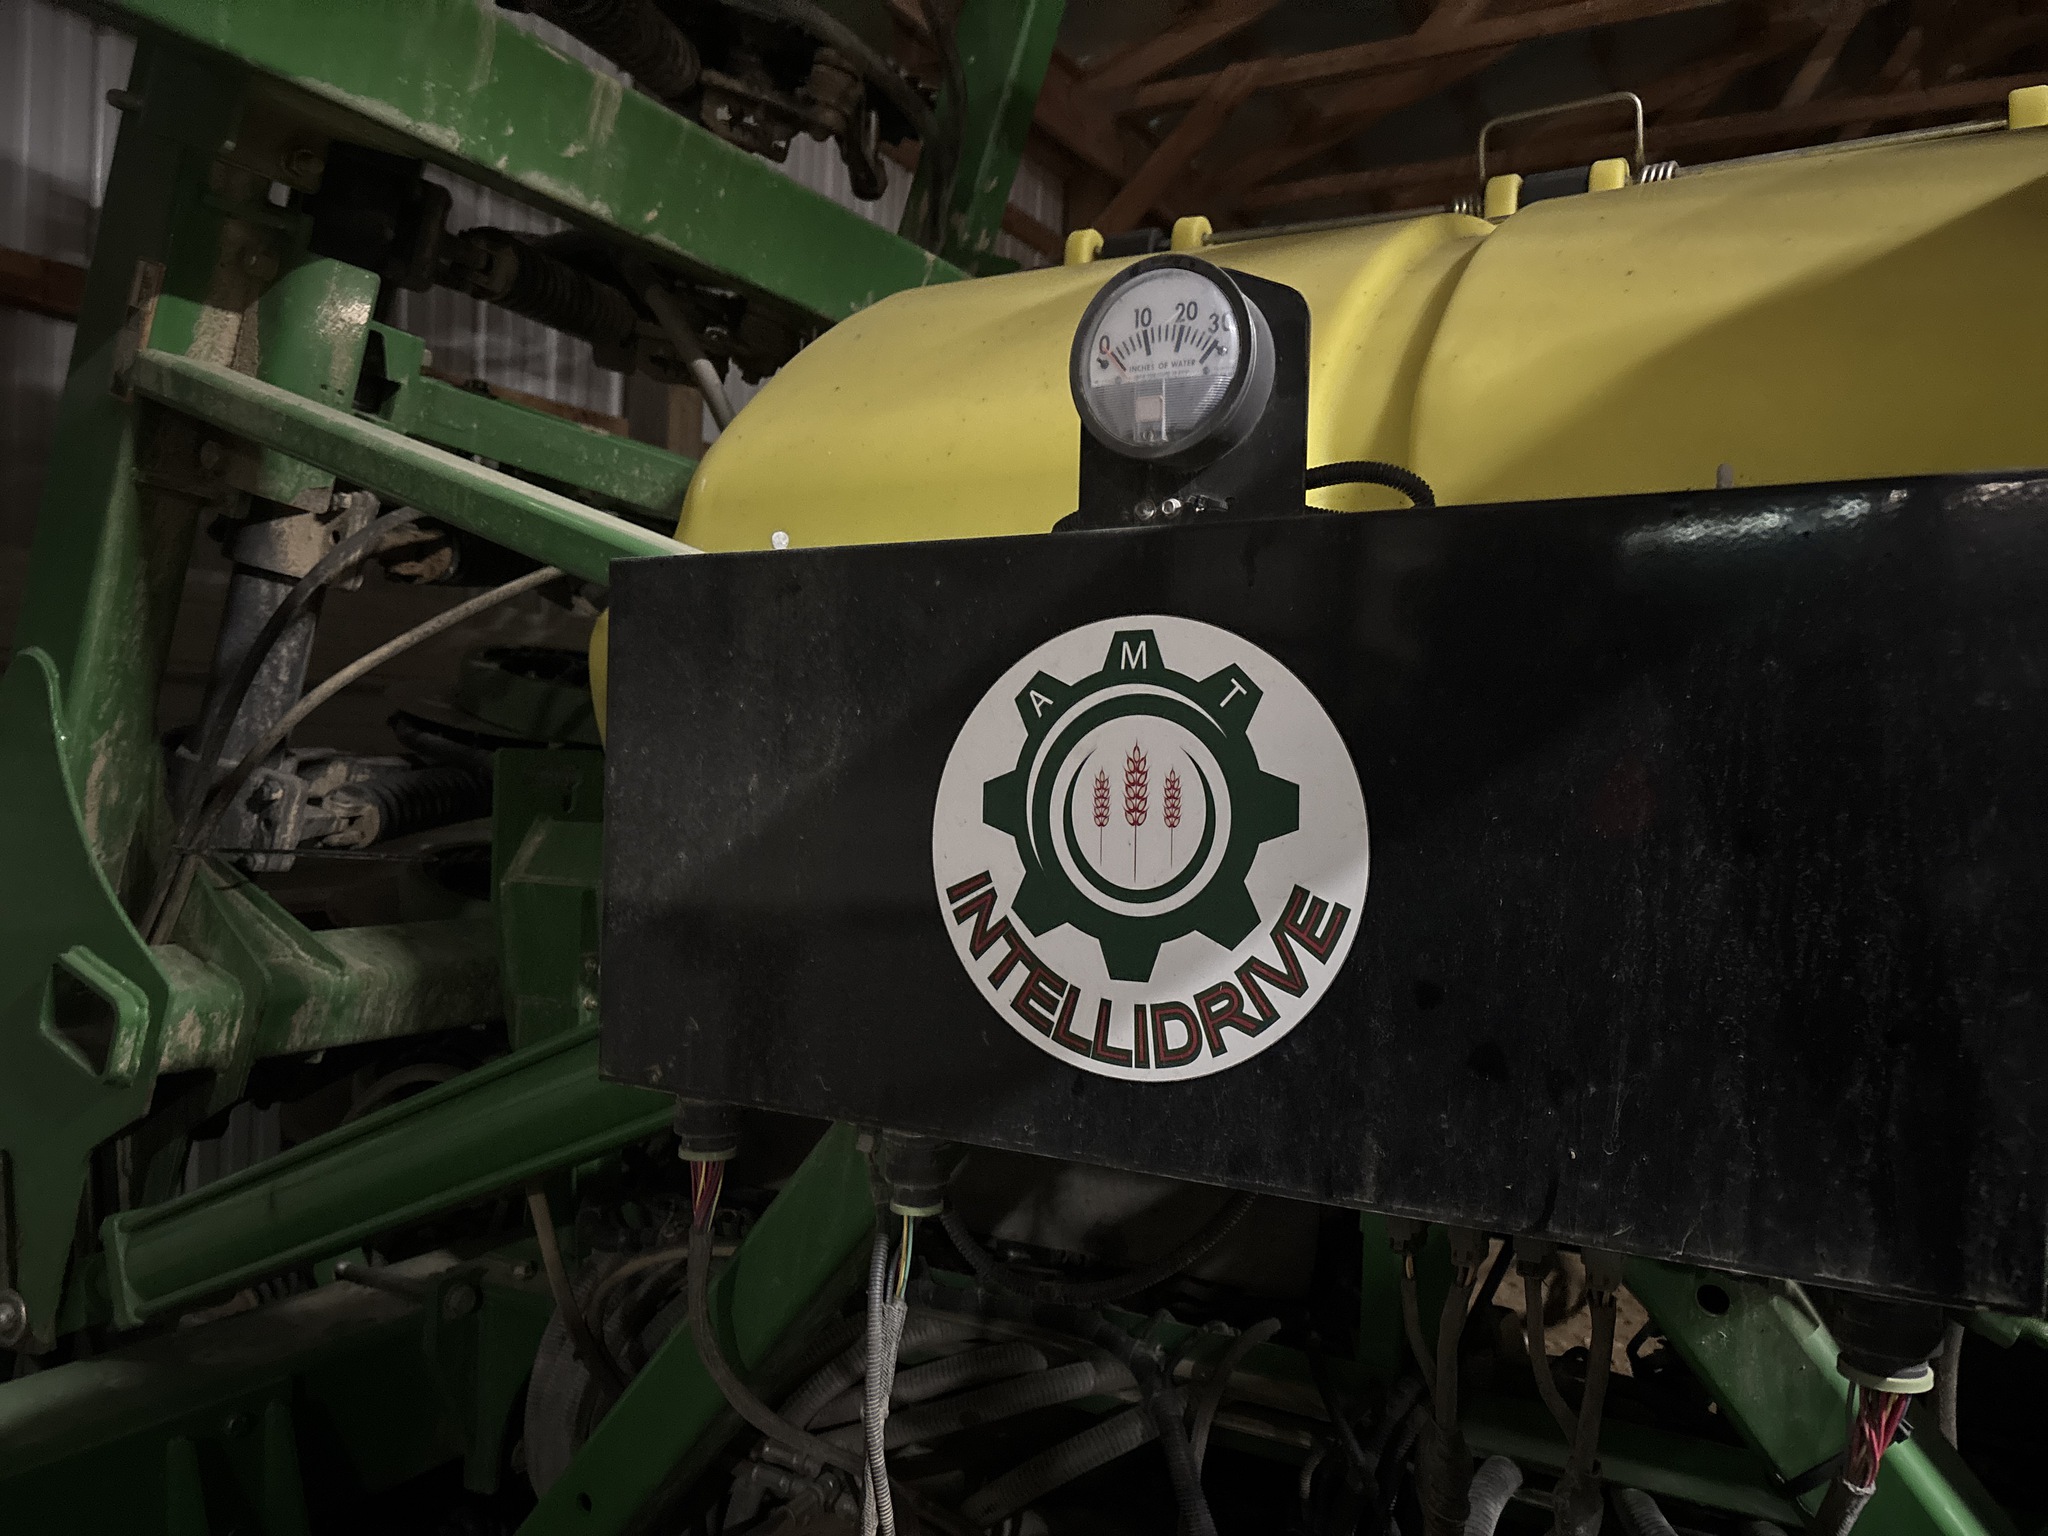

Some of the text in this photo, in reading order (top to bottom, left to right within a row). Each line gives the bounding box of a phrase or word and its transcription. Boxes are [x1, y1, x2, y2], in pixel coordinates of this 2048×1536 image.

[1099, 335, 1110, 355] 0
[1134, 307, 1152, 329] 10
[1175, 301, 1198, 323] 20
[1129, 359, 1196, 372] INCHES OF WATER
[946, 870, 1351, 1069] INTELLIDRIVE
